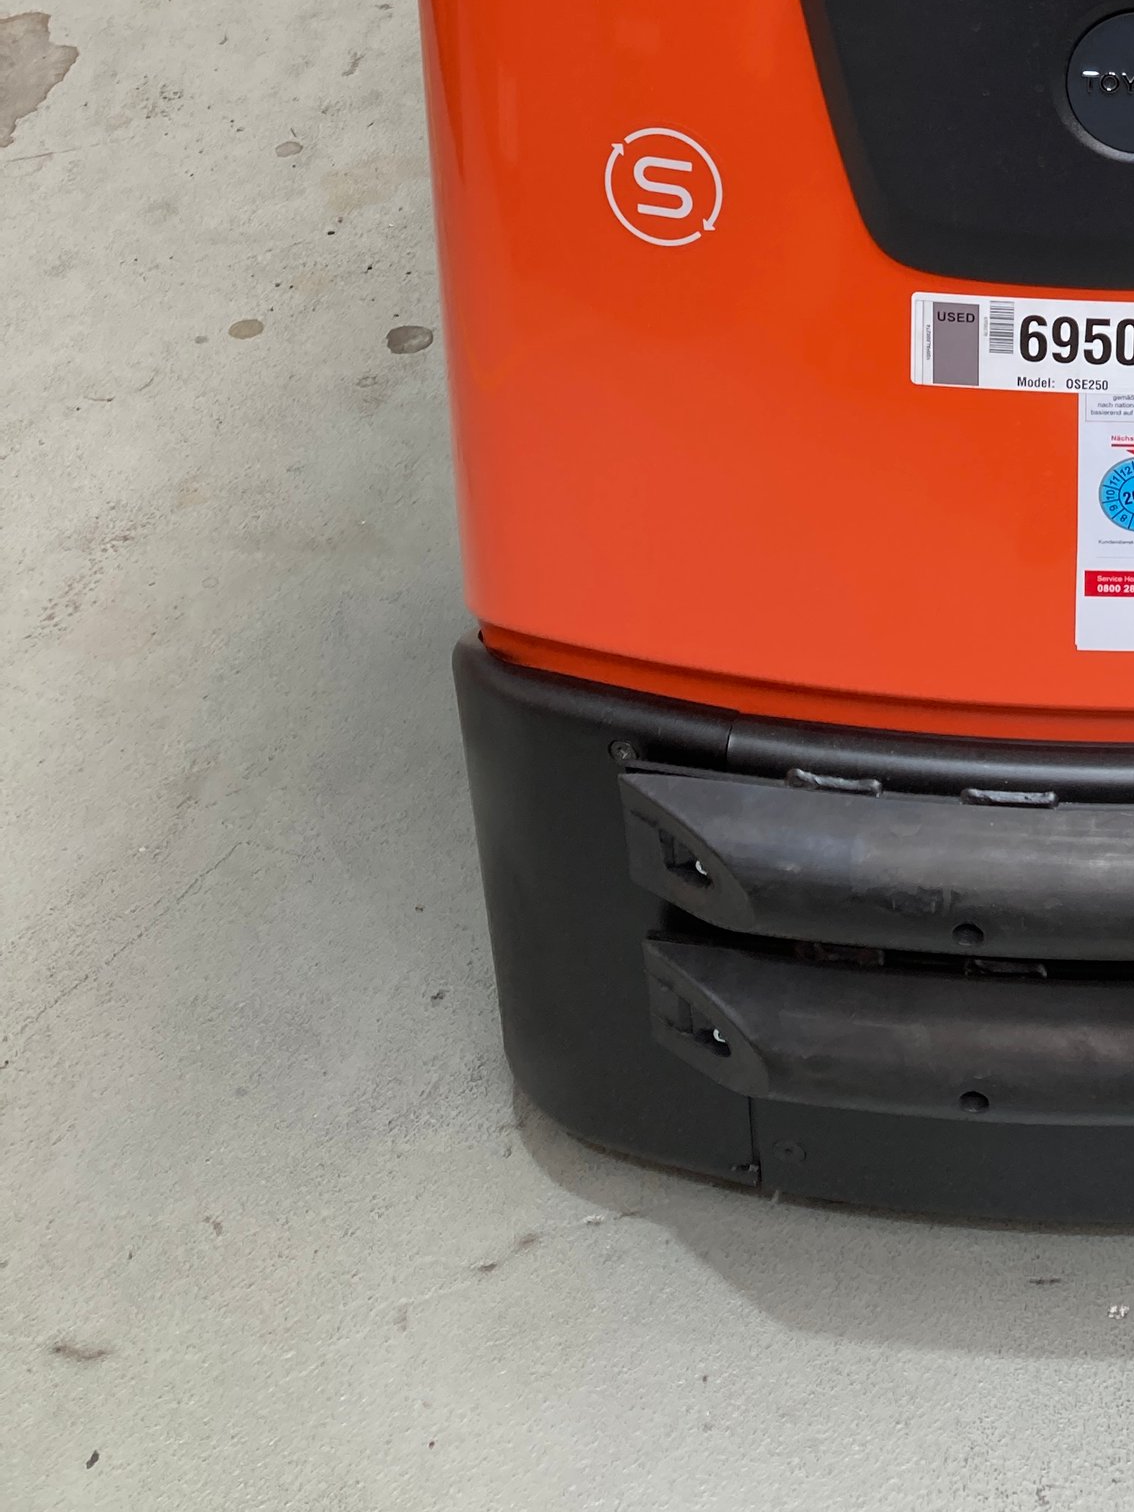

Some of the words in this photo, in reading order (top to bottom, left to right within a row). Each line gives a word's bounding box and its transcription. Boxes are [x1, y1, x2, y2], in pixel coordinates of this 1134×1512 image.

[937, 311, 976, 323] USED
[1017, 376, 1055, 388] Model:
[1066, 378, 1109, 391] OSE250
[1120, 466, 1132, 476] 12
[1110, 475, 1120, 486] 11
[1106, 490, 1115, 500] 10
[1120, 514, 1128, 522] 8
[1097, 584, 1121, 593] 0800
[1123, 584, 1134, 593] 28
